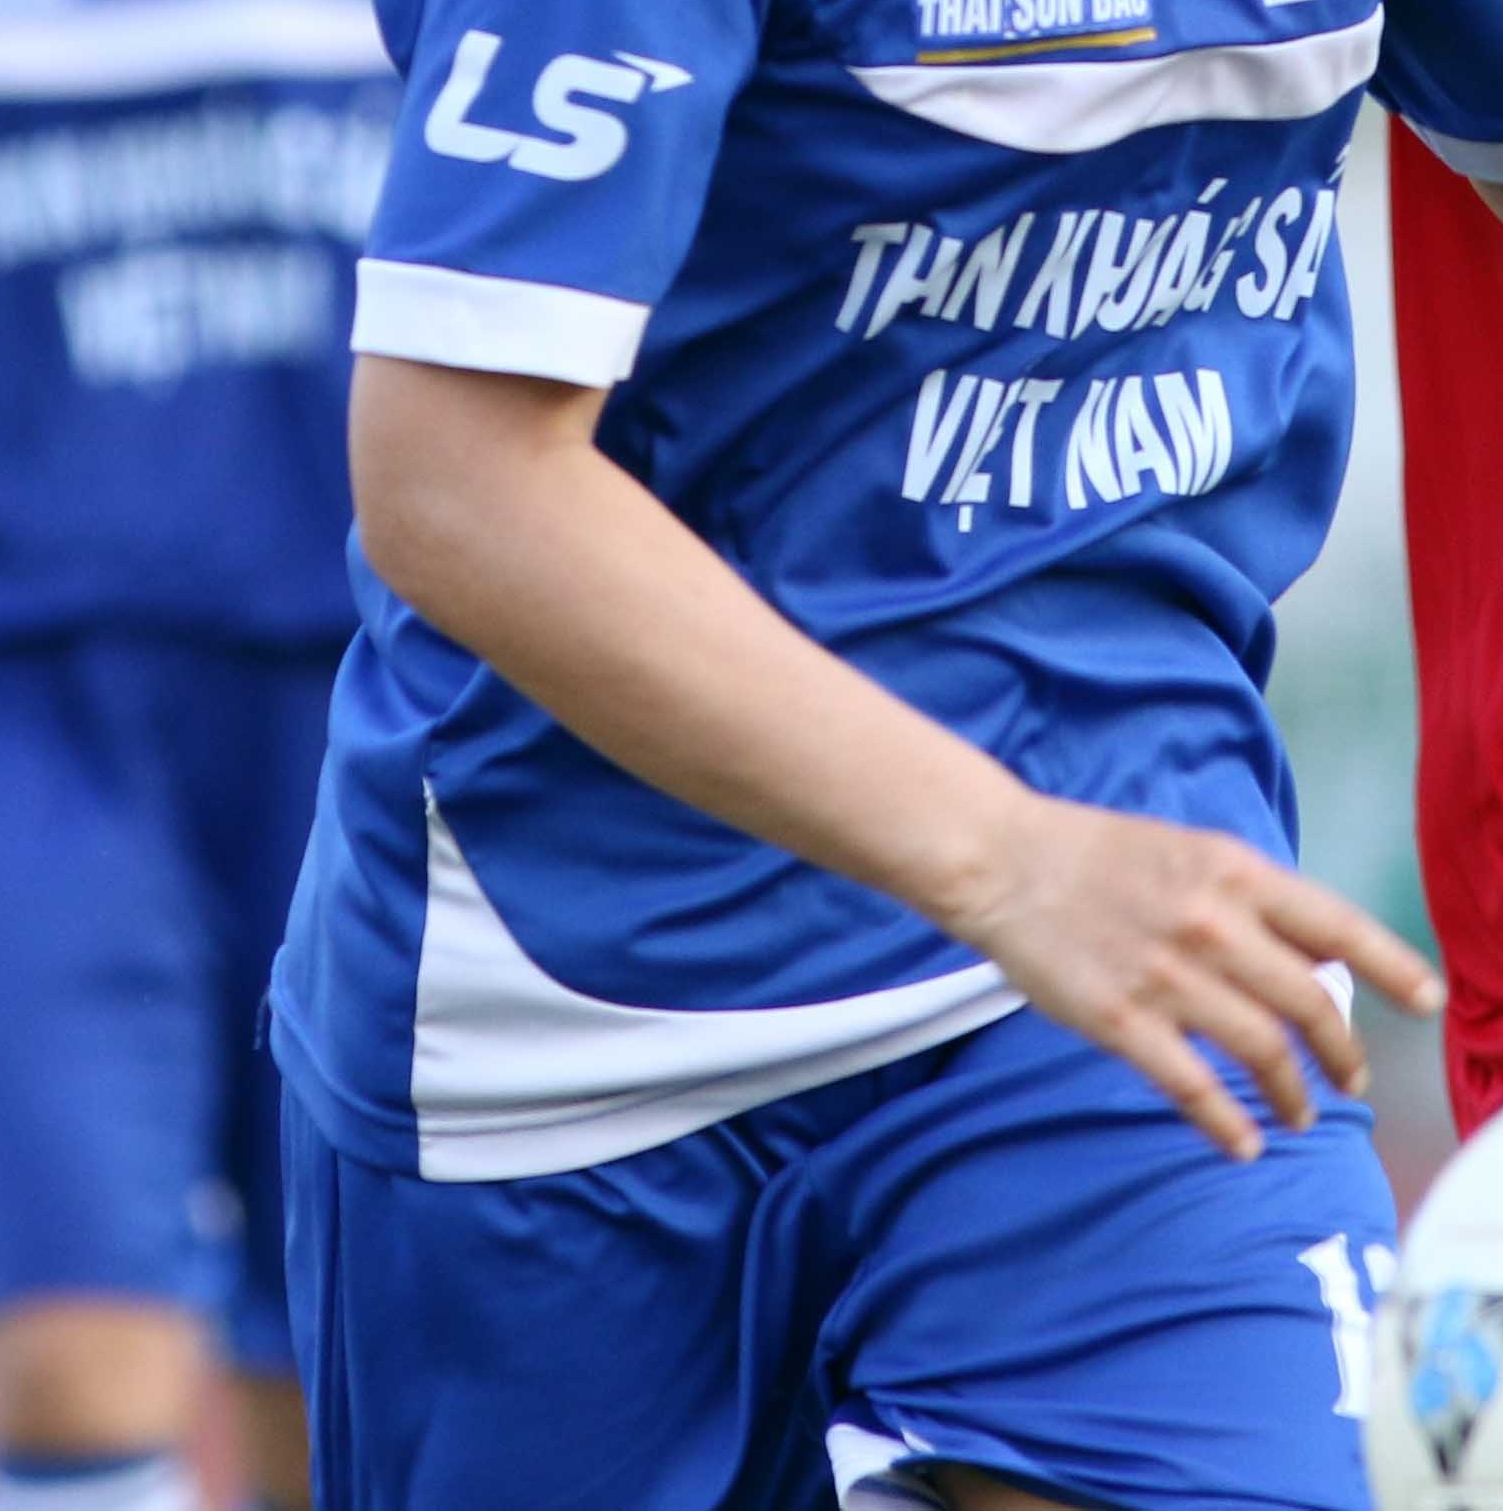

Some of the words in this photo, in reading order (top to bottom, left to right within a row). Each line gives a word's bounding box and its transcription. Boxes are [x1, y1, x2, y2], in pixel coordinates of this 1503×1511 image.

[423, 28, 646, 181] LS
[1064, 367, 1234, 510] NAM
[1296, 1231, 1398, 1420] 1
